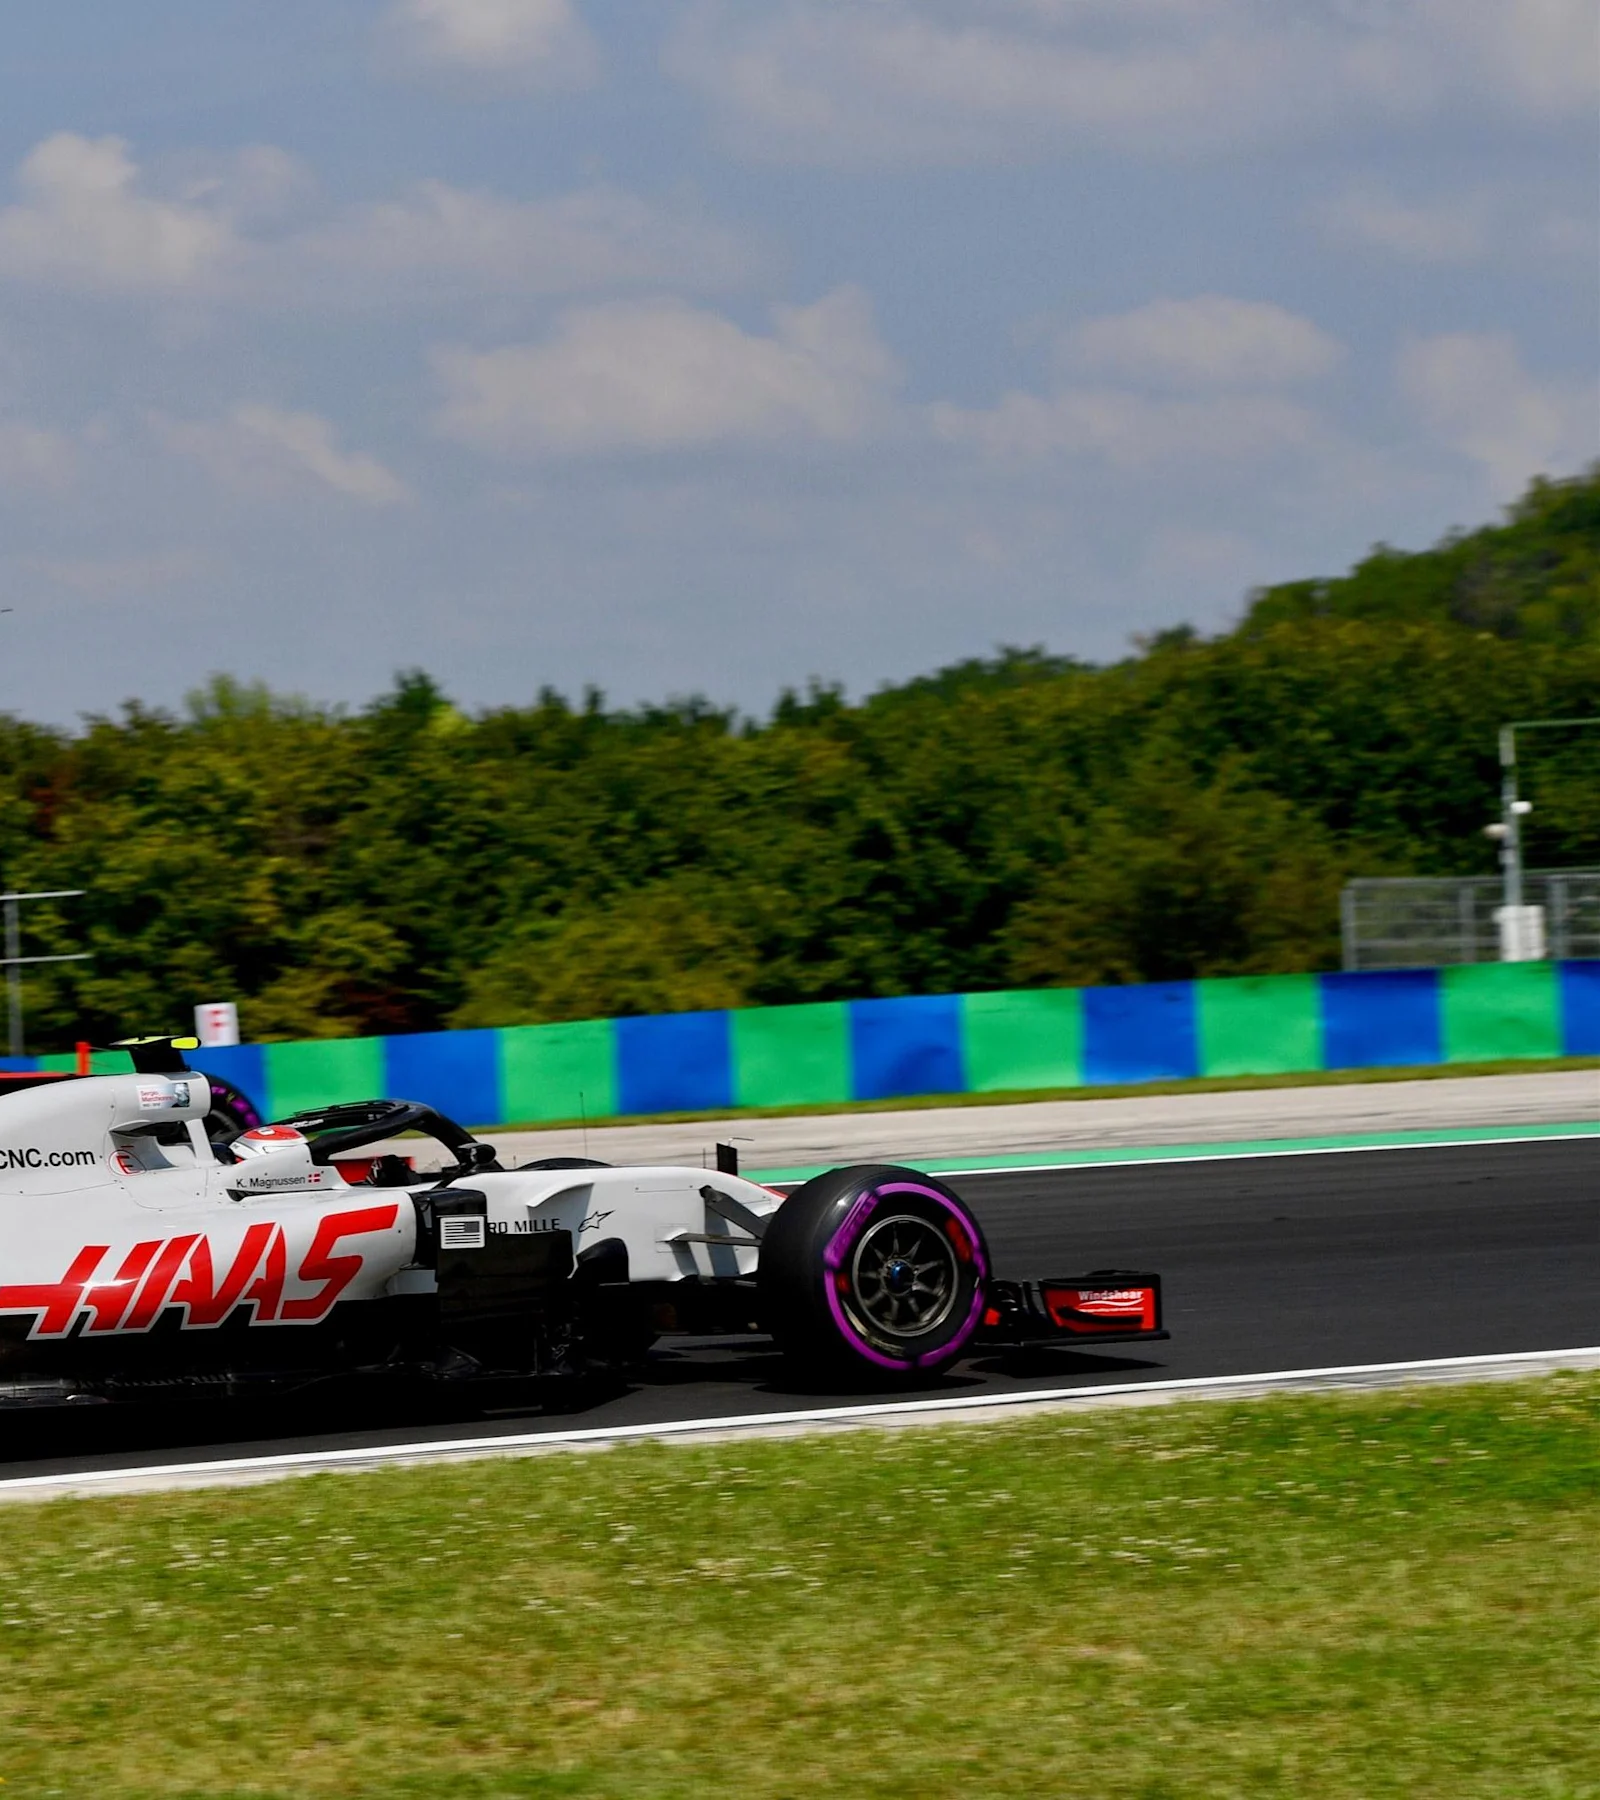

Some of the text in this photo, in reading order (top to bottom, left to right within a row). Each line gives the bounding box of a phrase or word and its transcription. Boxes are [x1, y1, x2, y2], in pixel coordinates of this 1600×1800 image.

[236, 1176, 306, 1189] K. Magnussen
[514, 1218, 561, 1233] MILLE
[1078, 1290, 1144, 1301] Windshear
